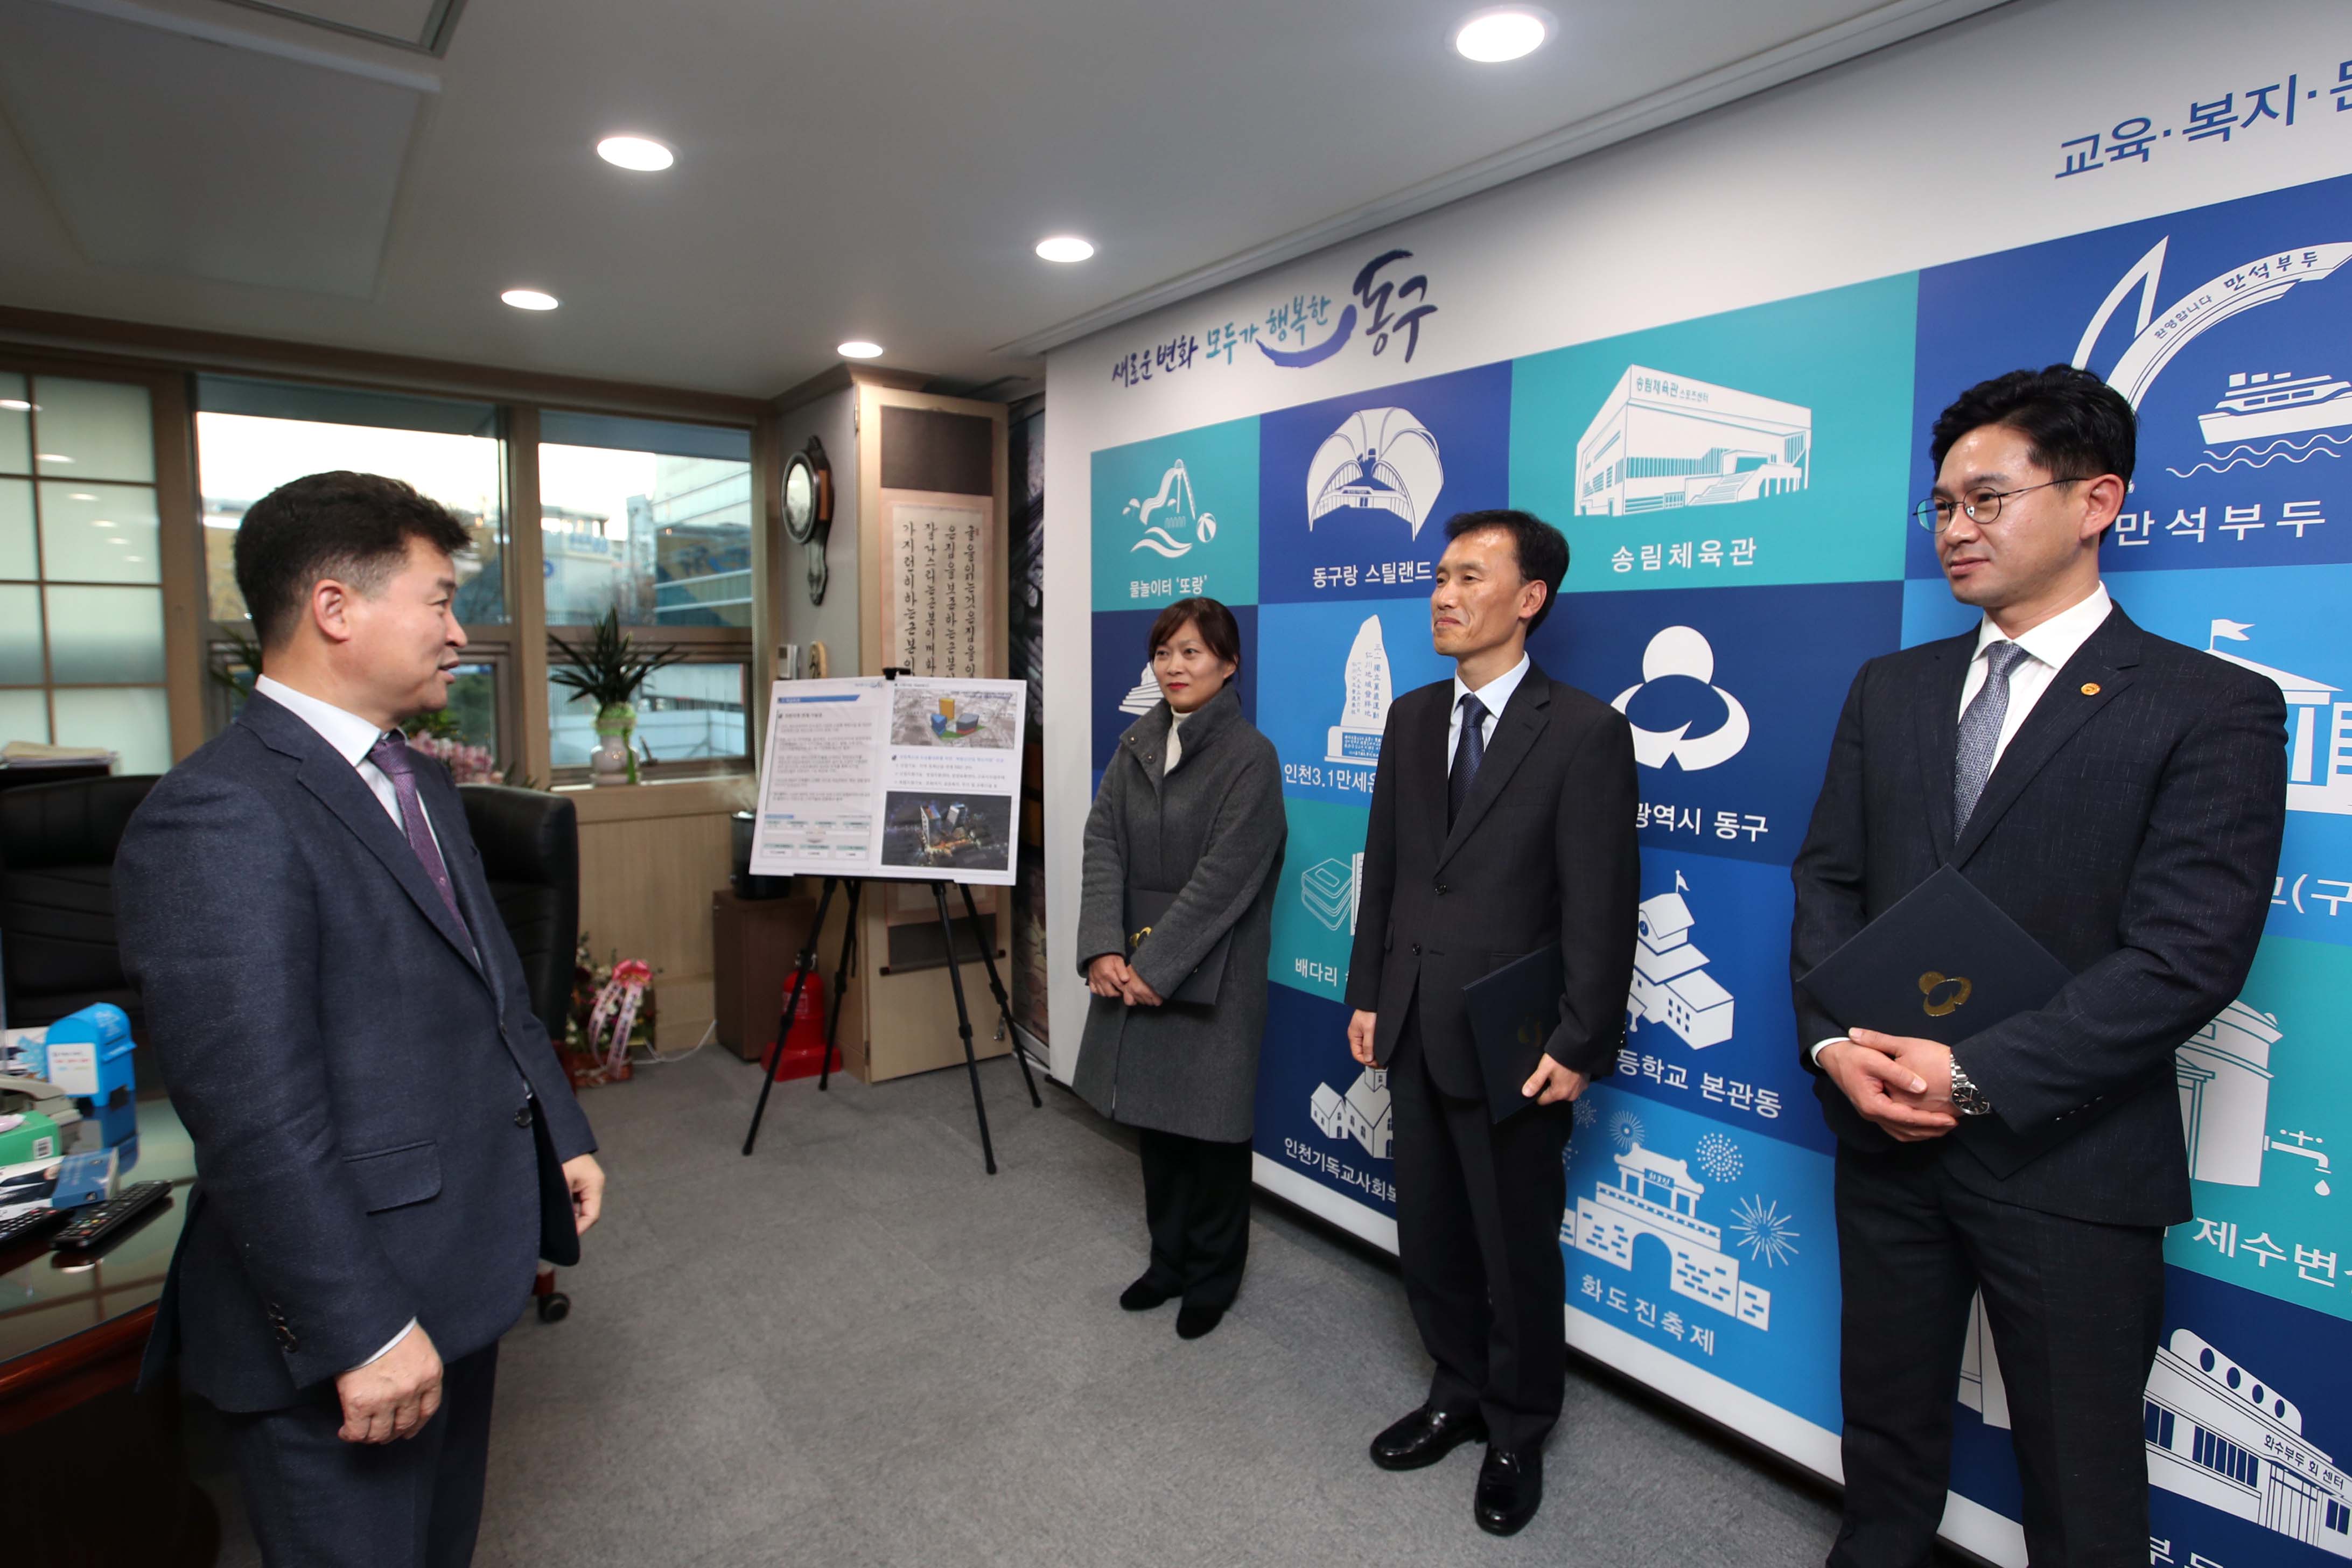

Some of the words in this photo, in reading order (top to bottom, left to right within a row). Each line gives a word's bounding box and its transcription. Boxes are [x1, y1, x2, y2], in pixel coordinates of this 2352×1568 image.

[2153, 294, 2213, 340] 환영합니다
[2223, 251, 2318, 291] 만석부두
[1111, 349, 1153, 388] 새로운
[1156, 334, 1199, 373] 변화
[1206, 321, 1259, 365] 모두가
[1265, 295, 1332, 346] 행복한
[1352, 249, 1439, 363] 동구
[1636, 375, 1679, 397] 송림체육관
[2115, 500, 2327, 547] 만석부두
[1611, 537, 1758, 573] 송림체육관
[1129, 578, 1172, 599] 물놀이터
[1312, 564, 1359, 589] 동구랑
[1364, 560, 1433, 584] 스틸랜드
[1713, 811, 1769, 843] 동구
[1295, 957, 1338, 987] 배다리
[1616, 1048, 1689, 1090] 등학교
[1699, 1072, 1783, 1119] 본관동
[2192, 1216, 2352, 1296] 제수변
[1580, 1273, 1715, 1357] 화도진축제
[2264, 1434, 2305, 1467] 화수부두
